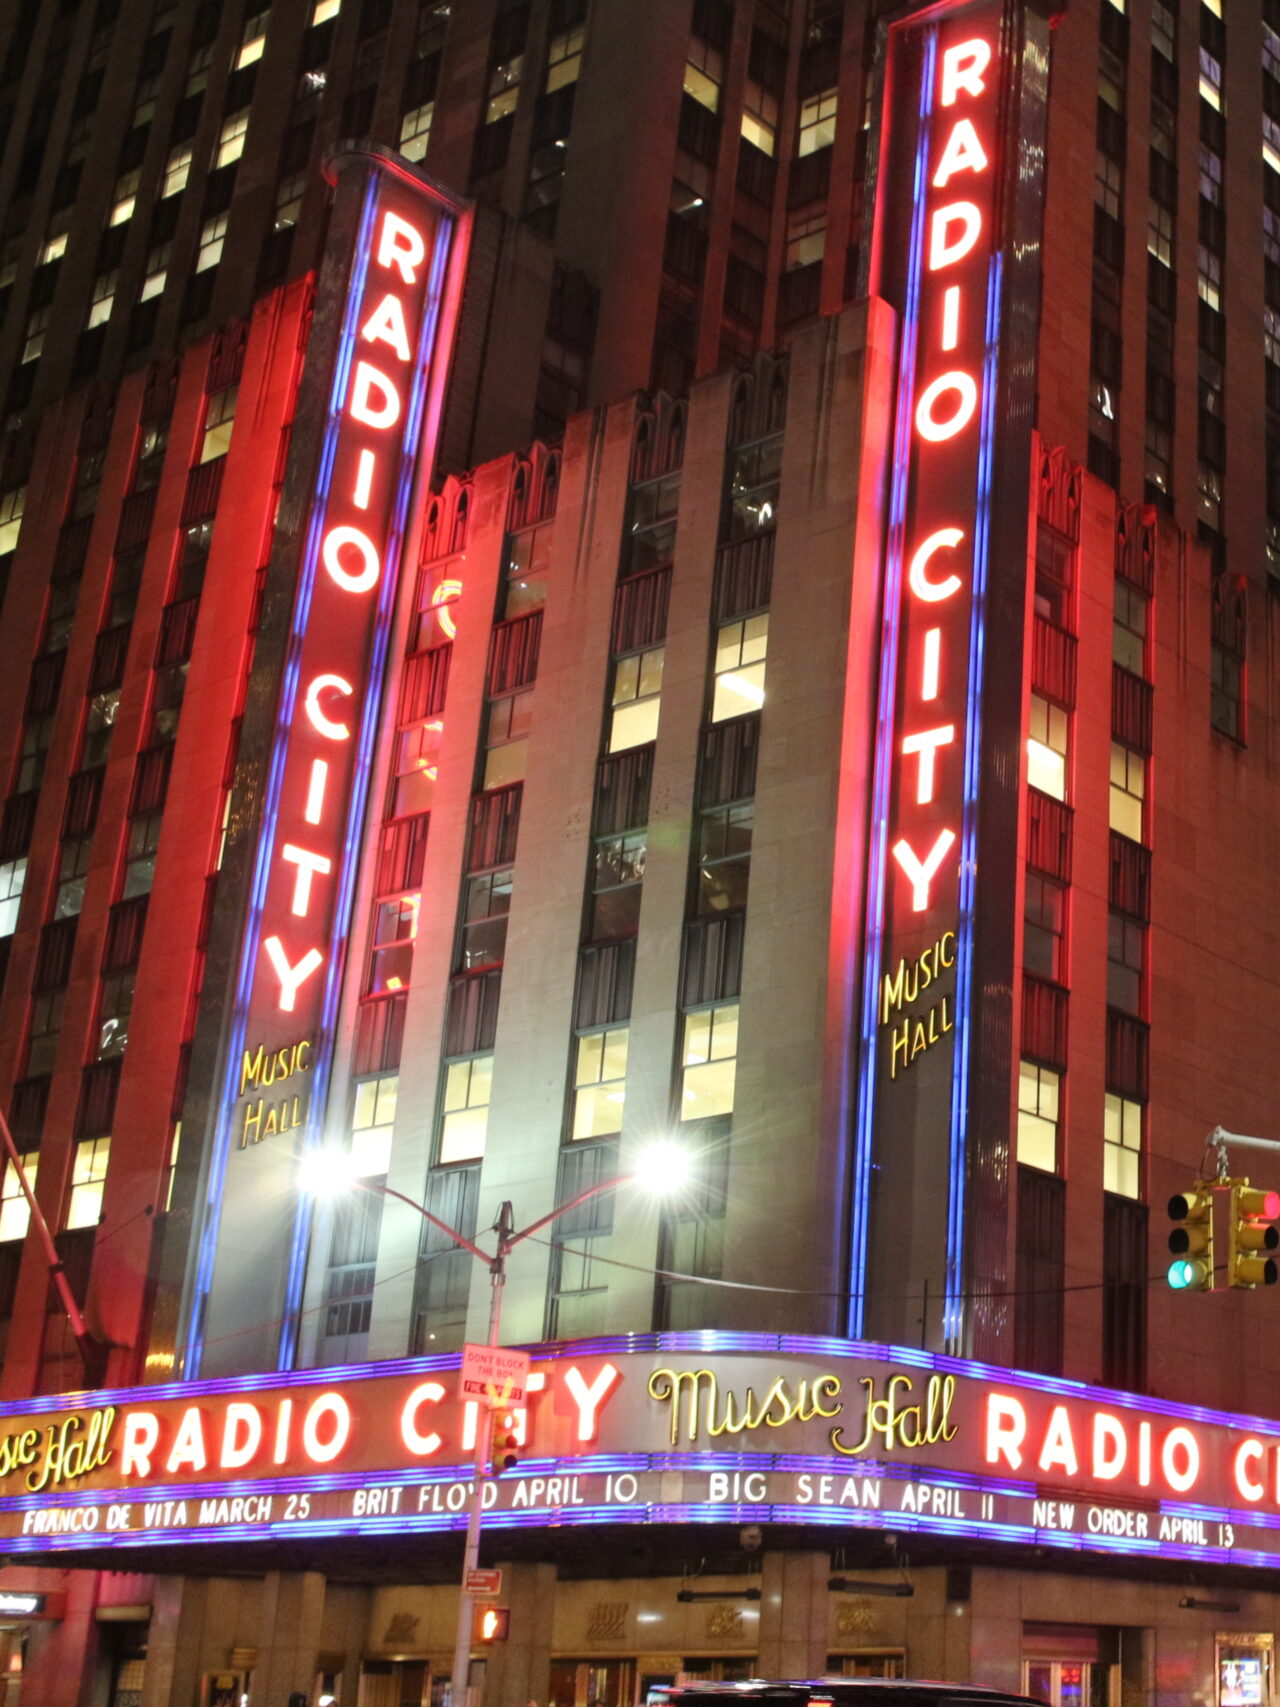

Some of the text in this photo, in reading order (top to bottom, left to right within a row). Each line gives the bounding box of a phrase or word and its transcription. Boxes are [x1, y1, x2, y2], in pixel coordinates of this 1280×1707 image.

[892, 37, 992, 912] RADIO CITY
[264, 210, 425, 1012] RADIO CITY
[880, 931, 955, 1025] MUSIC
[239, 1040, 310, 1097] MUSIC
[890, 996, 954, 1079] HALL
[239, 1097, 302, 1150] HALL
[25, 1407, 116, 1492] Hall
[121, 1392, 351, 1478] RADIO
[648, 1368, 958, 1455] Music Hall
[985, 1391, 1201, 1493] RADIO
[22, 1494, 311, 1535] FRANCO DE VITA MARCH 25
[353, 1474, 639, 1517] BRIT FLOD APRIL 10
[709, 1473, 994, 1521] BIG SEAN APRIL 11
[1032, 1500, 1235, 1549] NEW ORDER APRIL 13
